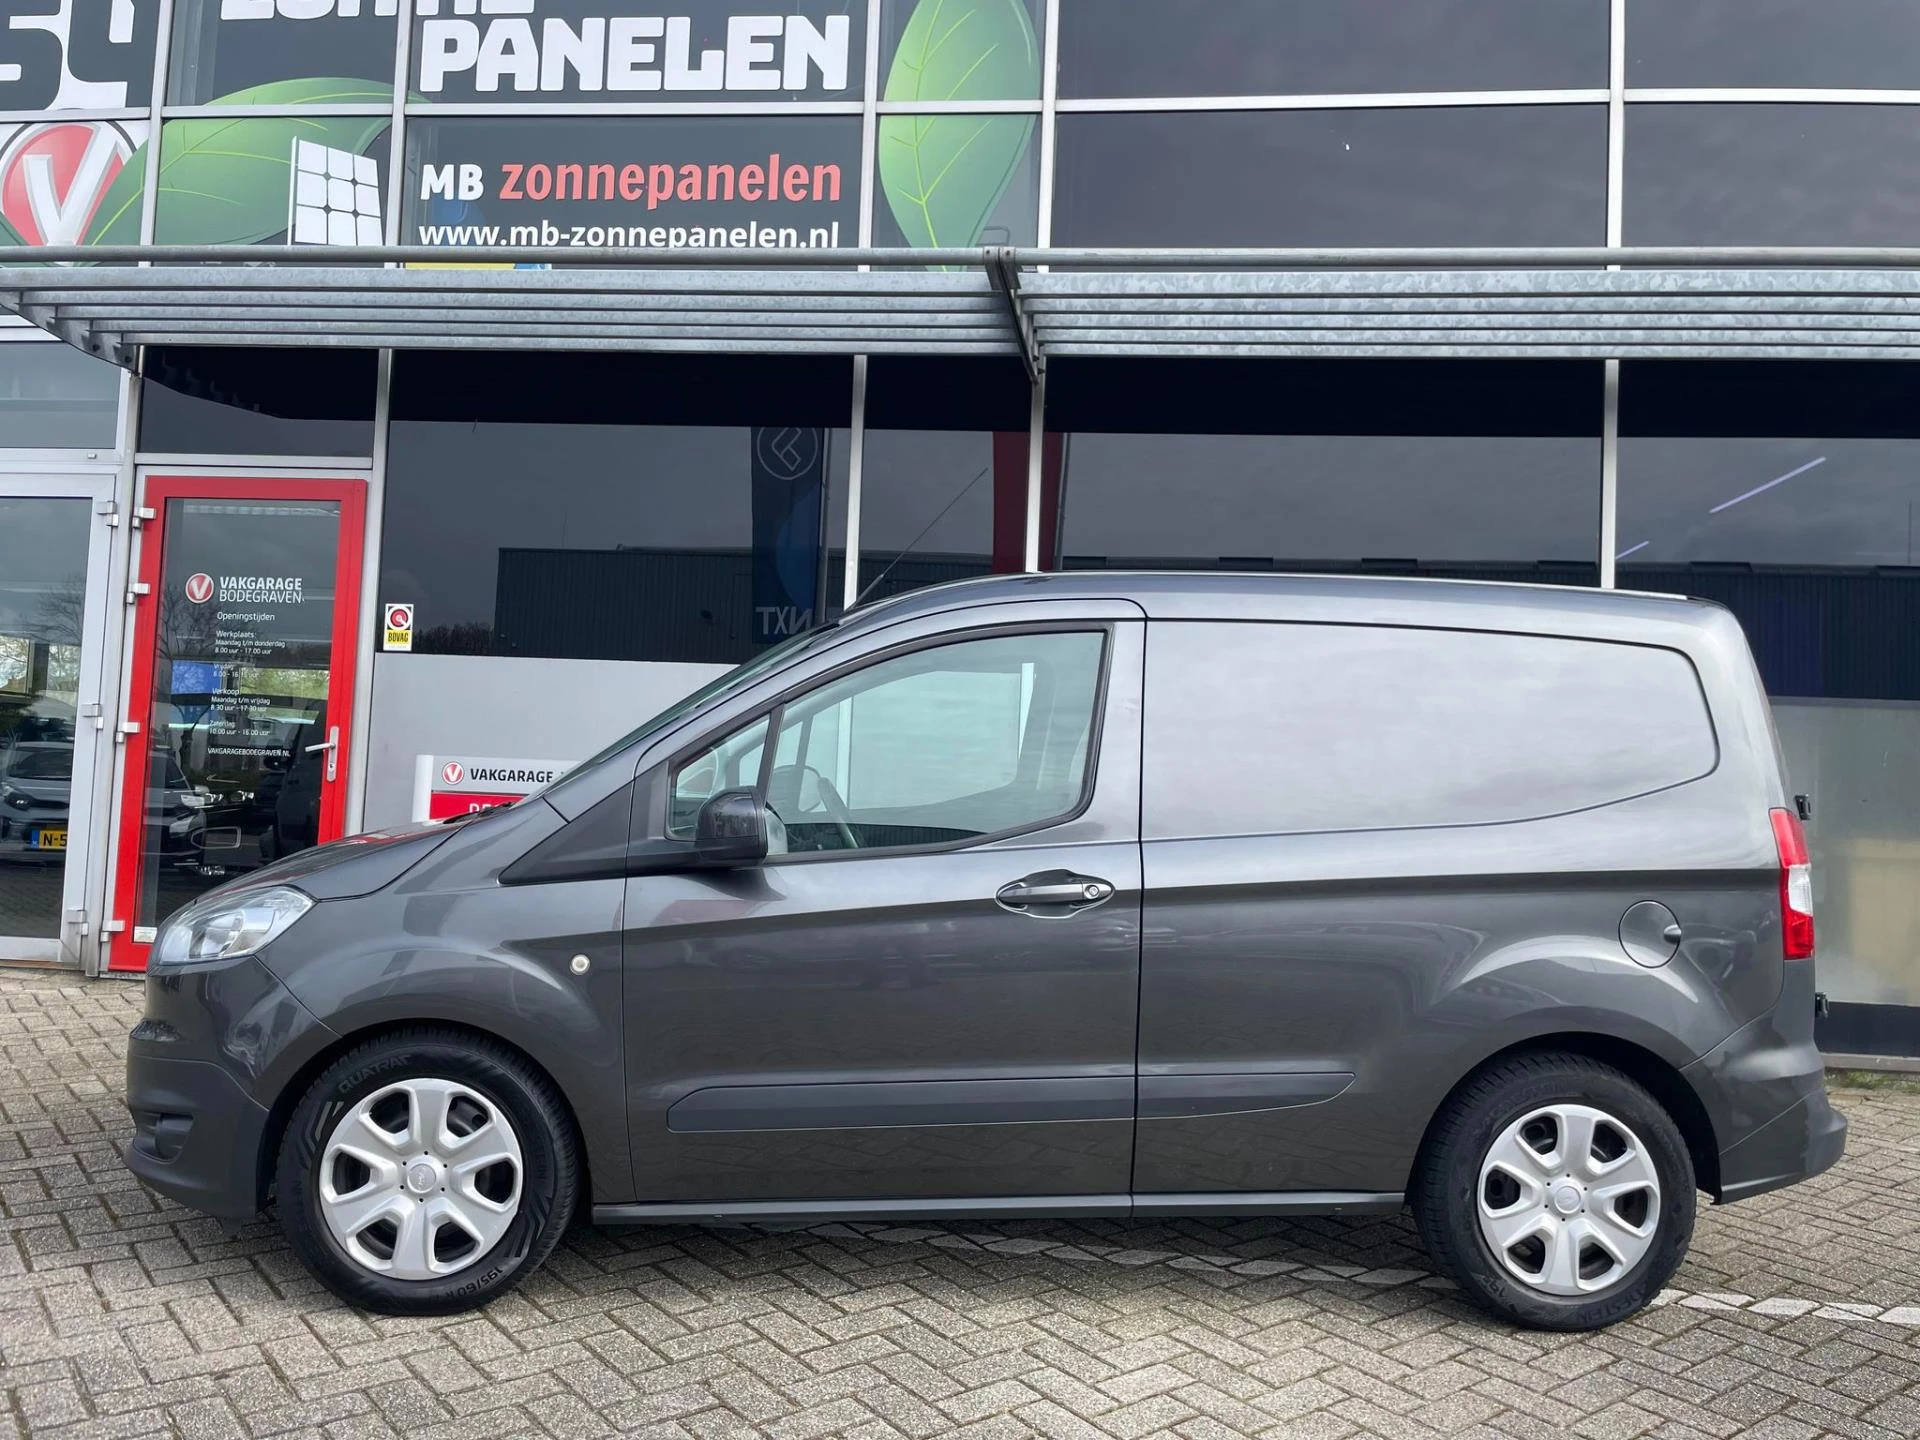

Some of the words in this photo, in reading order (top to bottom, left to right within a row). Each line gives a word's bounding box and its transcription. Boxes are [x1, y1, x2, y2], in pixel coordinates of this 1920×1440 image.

[420, 15, 849, 92] PANELEN
[420, 164, 485, 201] MB
[500, 152, 841, 210] zonnepanelen
[419, 220, 839, 248] www.mb-zonnepanelen.nl
[220, 576, 303, 590] VAKGARAGE
[219, 590, 302, 603] BODEGRAVEN
[217, 611, 275, 623] Openingstijden
[388, 632, 409, 643] BOVAG
[470, 768, 554, 783] VAKGARAGE
